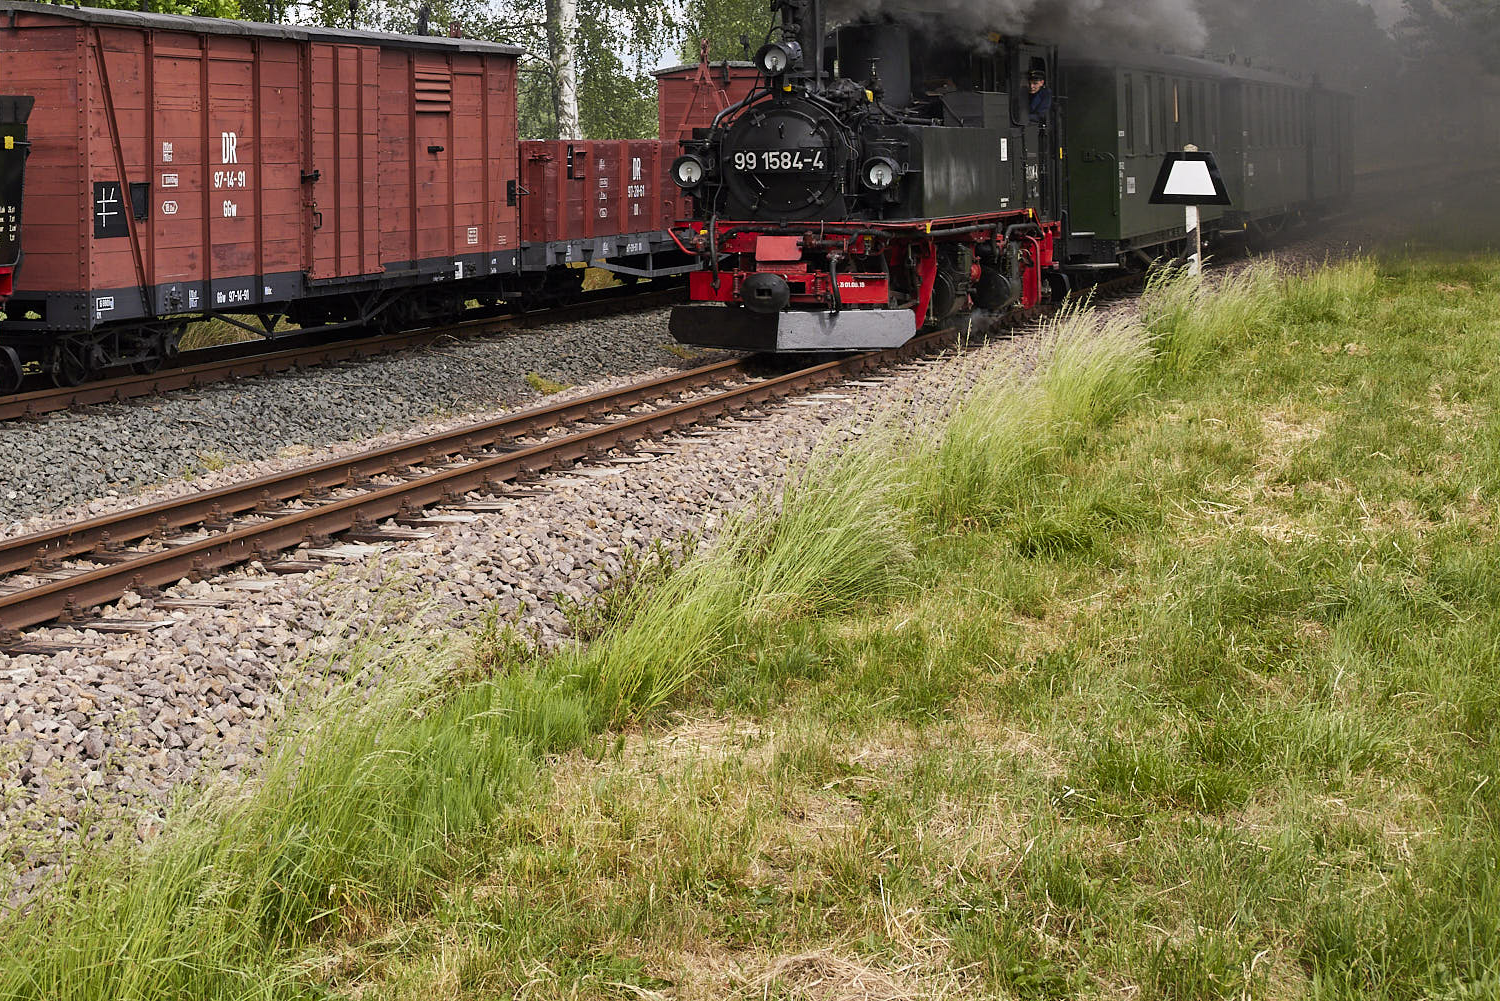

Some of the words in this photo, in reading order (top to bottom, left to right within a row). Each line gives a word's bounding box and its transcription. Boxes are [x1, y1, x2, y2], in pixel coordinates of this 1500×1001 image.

[222, 132, 238, 164] DR
[632, 157, 642, 181] DR
[734, 152, 757, 170] 99
[761, 151, 825, 170] 1584-4
[213, 170, 246, 188] 97-14-91
